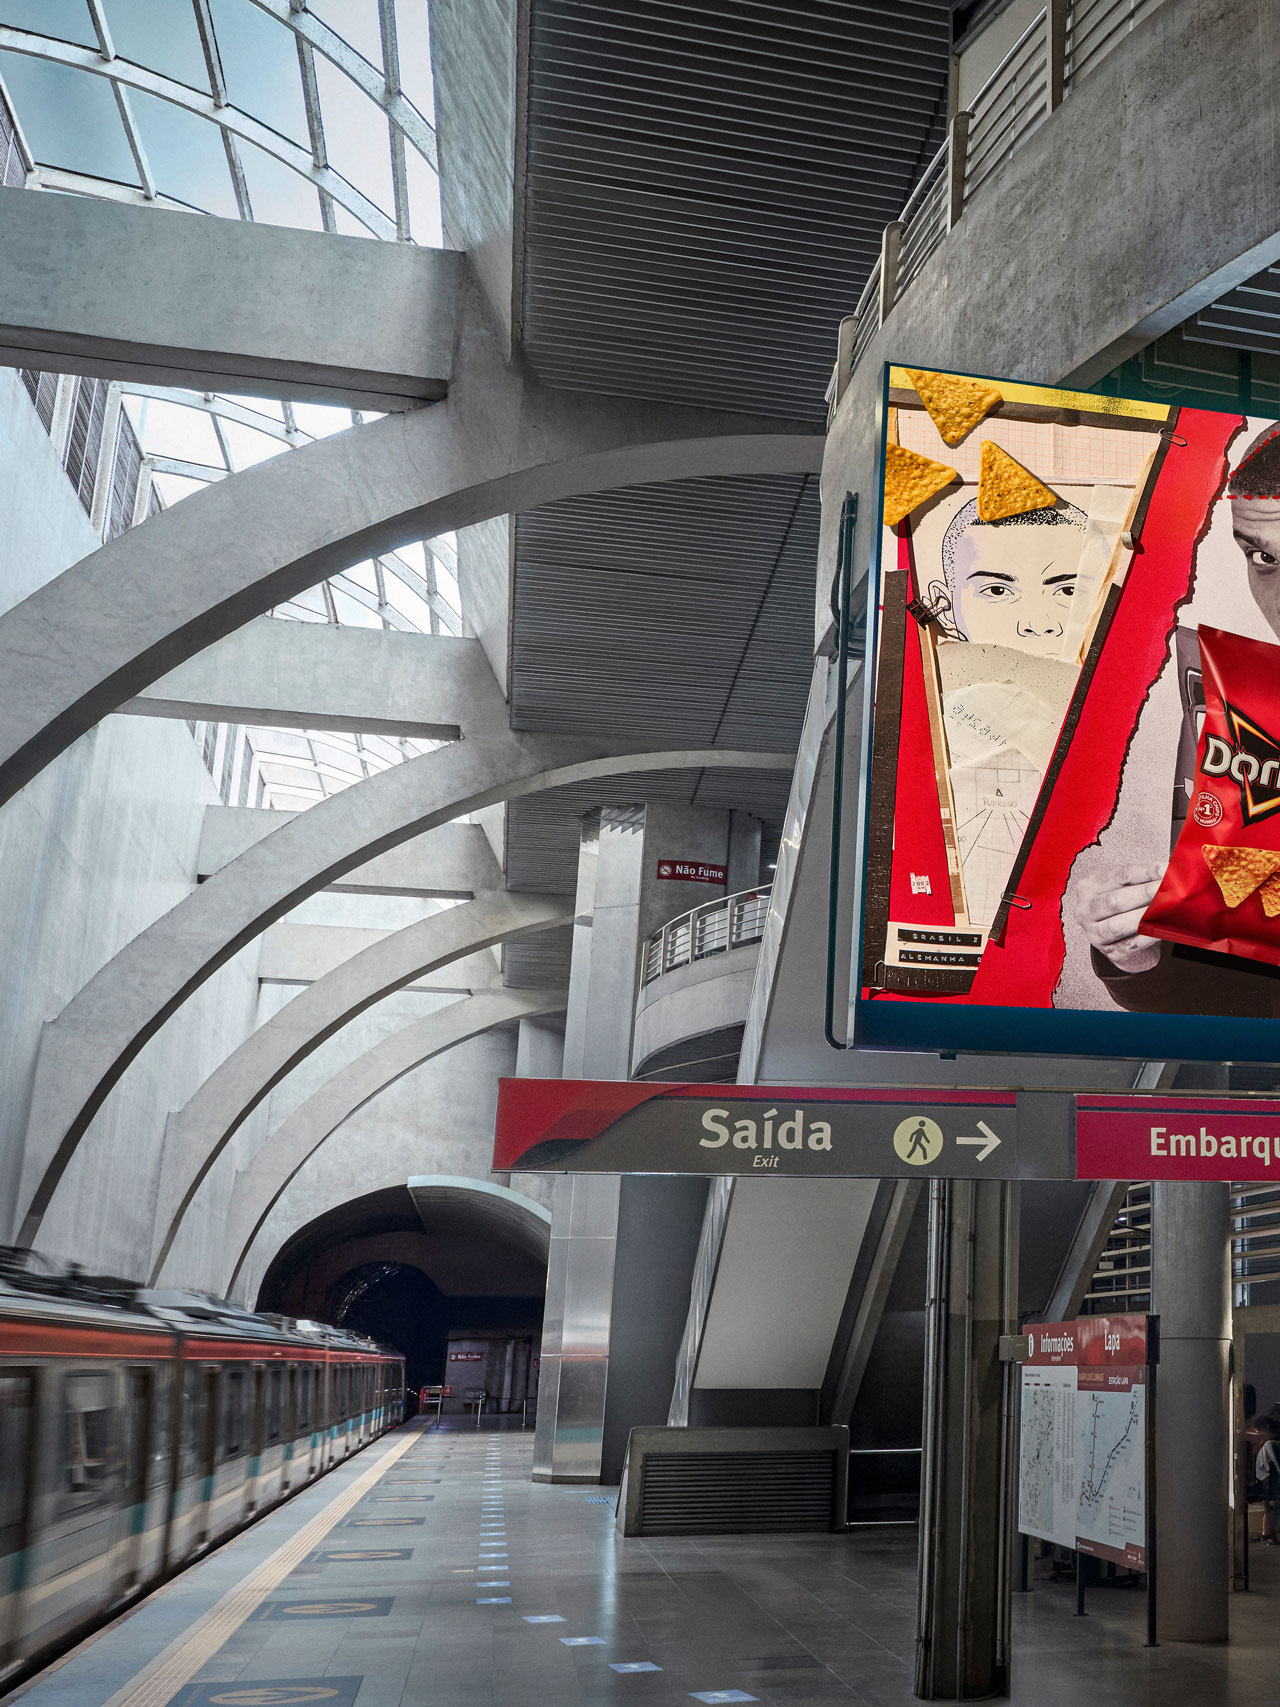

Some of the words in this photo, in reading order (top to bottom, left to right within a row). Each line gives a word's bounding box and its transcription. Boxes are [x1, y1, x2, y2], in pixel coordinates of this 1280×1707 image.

[675, 864, 696, 875] Não
[698, 866, 724, 879] Fume
[912, 933, 962, 943] BRASIL
[900, 953, 965, 963] ALEMANHA
[699, 1108, 833, 1151] Saída
[752, 1155, 780, 1168] Exit
[1040, 1332, 1074, 1357] Informações
[1104, 1329, 1121, 1356] Lapa
